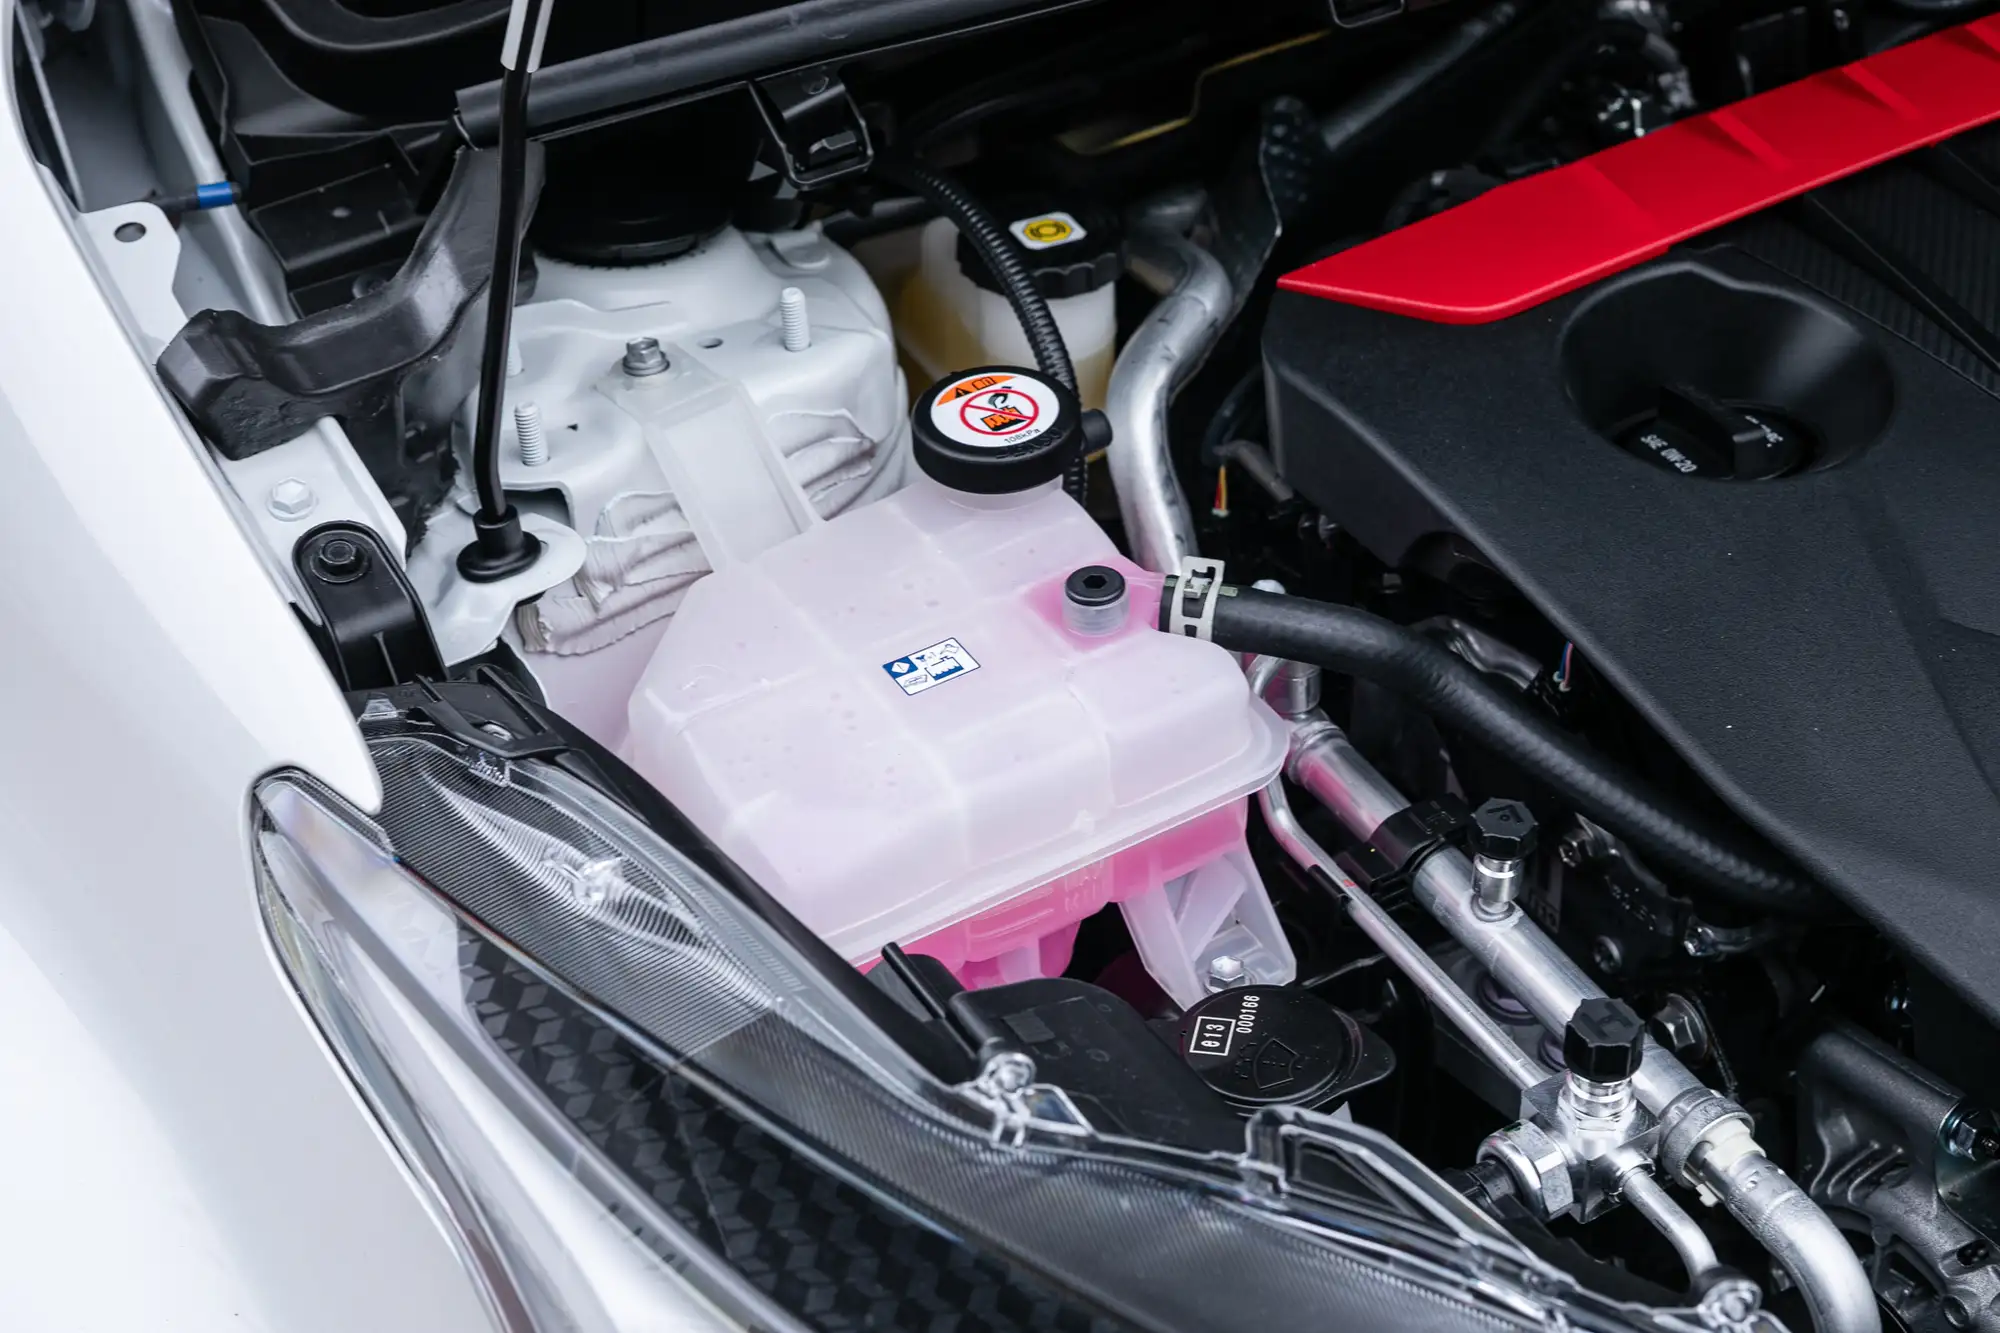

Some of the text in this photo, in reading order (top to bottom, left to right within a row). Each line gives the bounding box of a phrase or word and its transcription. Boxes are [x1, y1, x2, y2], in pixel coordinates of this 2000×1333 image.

[1004, 428, 1041, 444] 108kPa
[1640, 434, 1668, 450] SAE
[1235, 995, 1260, 1034] 000166
[1580, 1001, 1633, 1040] H
[1200, 1024, 1225, 1048] e13
